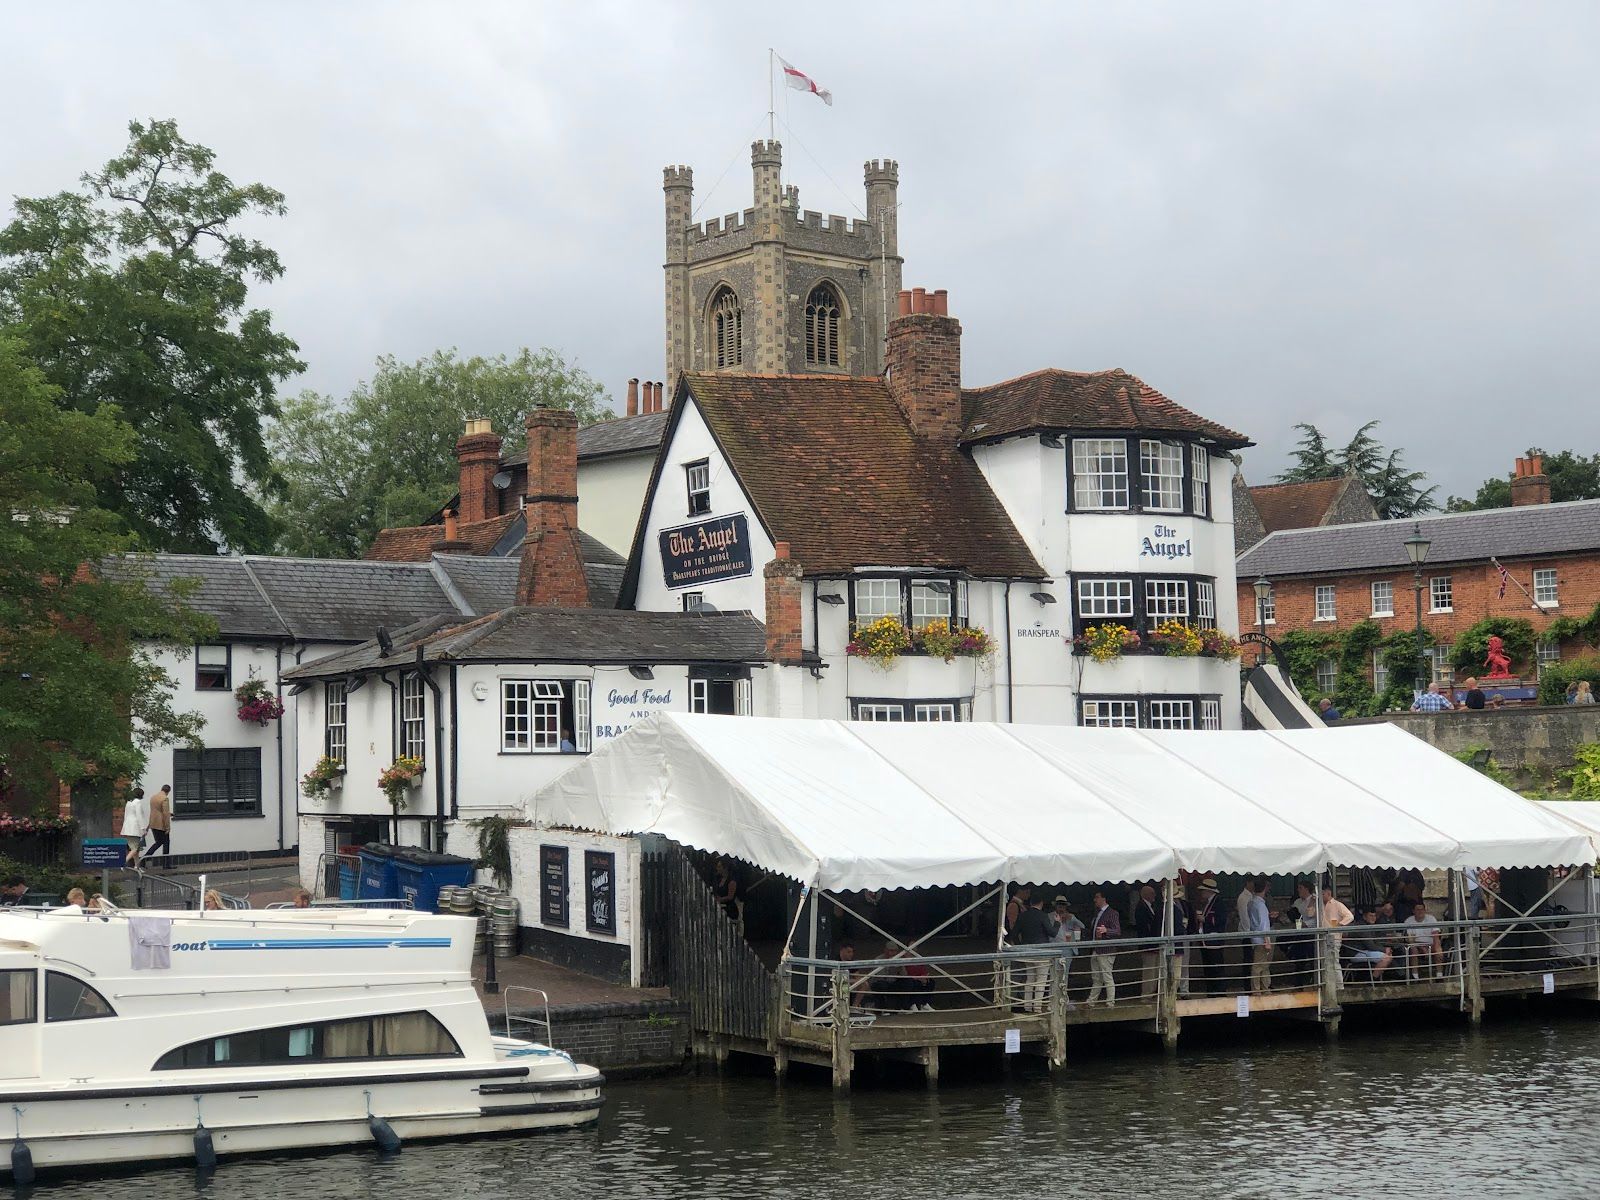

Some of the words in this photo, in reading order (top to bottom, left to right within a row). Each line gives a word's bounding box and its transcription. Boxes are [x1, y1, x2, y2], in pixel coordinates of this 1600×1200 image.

[1153, 524, 1177, 537] The
[669, 532, 695, 557] The
[698, 520, 738, 551] Angel
[1139, 537, 1192, 560] Angel
[683, 560, 692, 568] ON
[694, 557, 705, 566] THE
[709, 551, 730, 563] BRIDGE
[702, 562, 732, 576] TRADITIONAL
[732, 561, 745, 570] ALES
[1017, 629, 1060, 638] BRAKSPEAR
[1240, 634, 1251, 645] HE
[1251, 634, 1272, 647] ANGEL
[607, 688, 639, 707] Good
[642, 688, 672, 704] Food
[629, 710, 650, 719] AND
[596, 725, 633, 738] BRA
